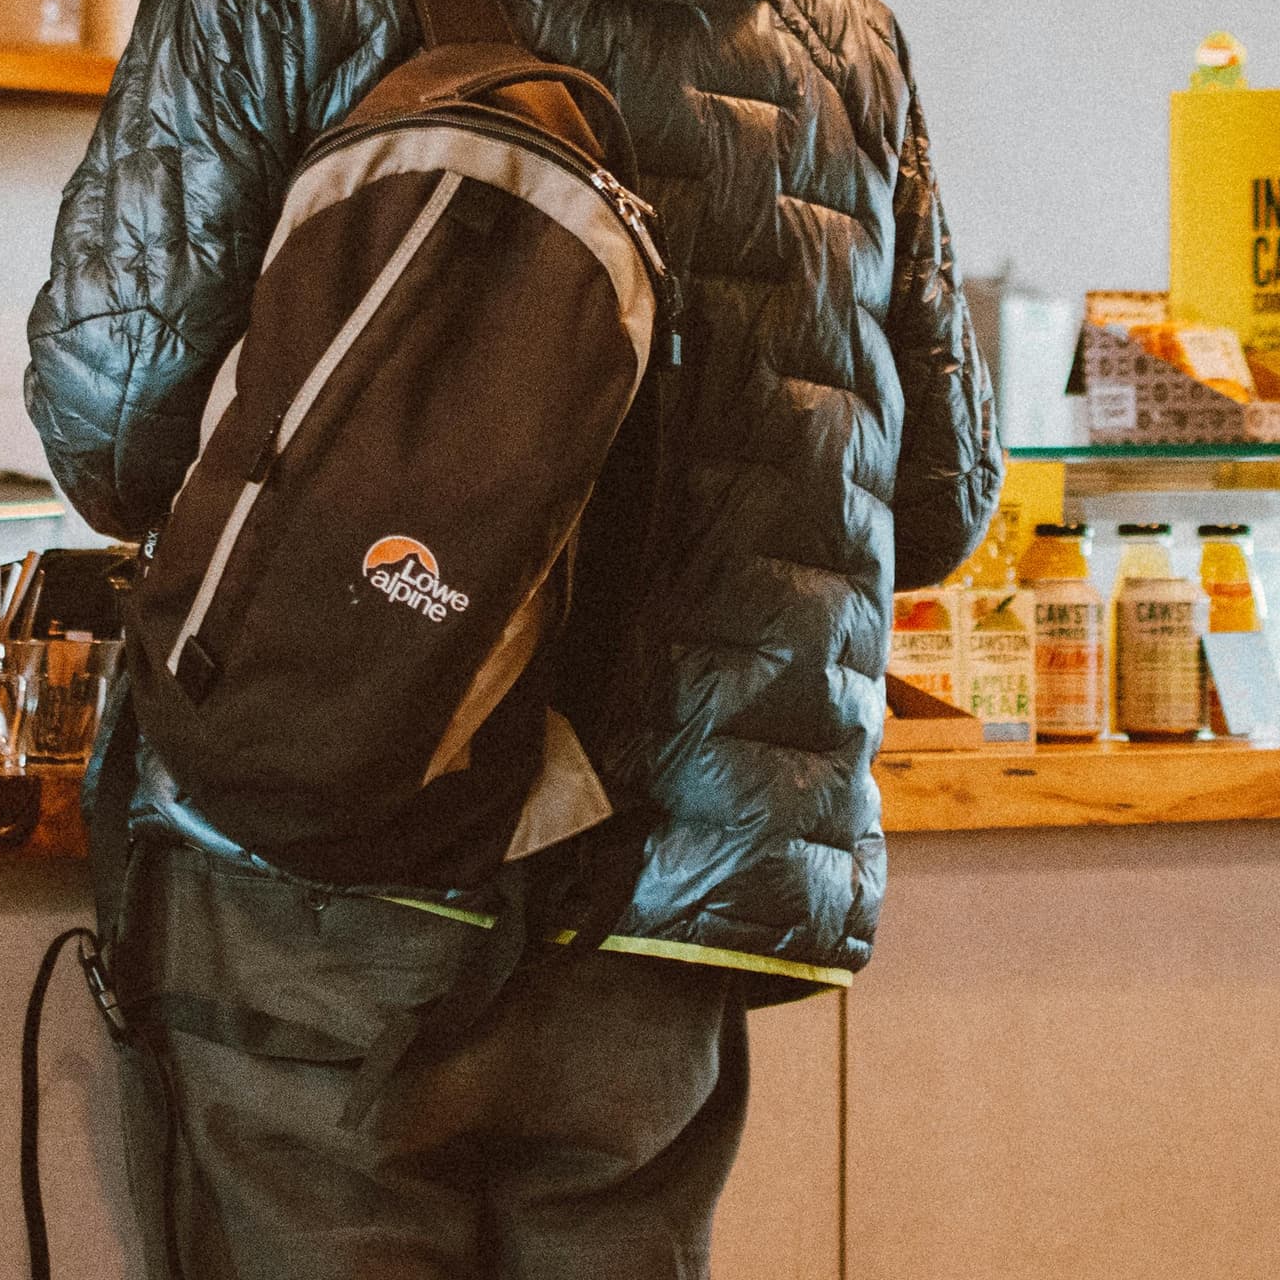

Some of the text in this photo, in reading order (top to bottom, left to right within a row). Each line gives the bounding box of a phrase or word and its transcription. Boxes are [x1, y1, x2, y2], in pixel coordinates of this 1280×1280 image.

[370, 570, 448, 622] alpine
[400, 559, 470, 612] Lowe
[971, 694, 1029, 716] PEAR
